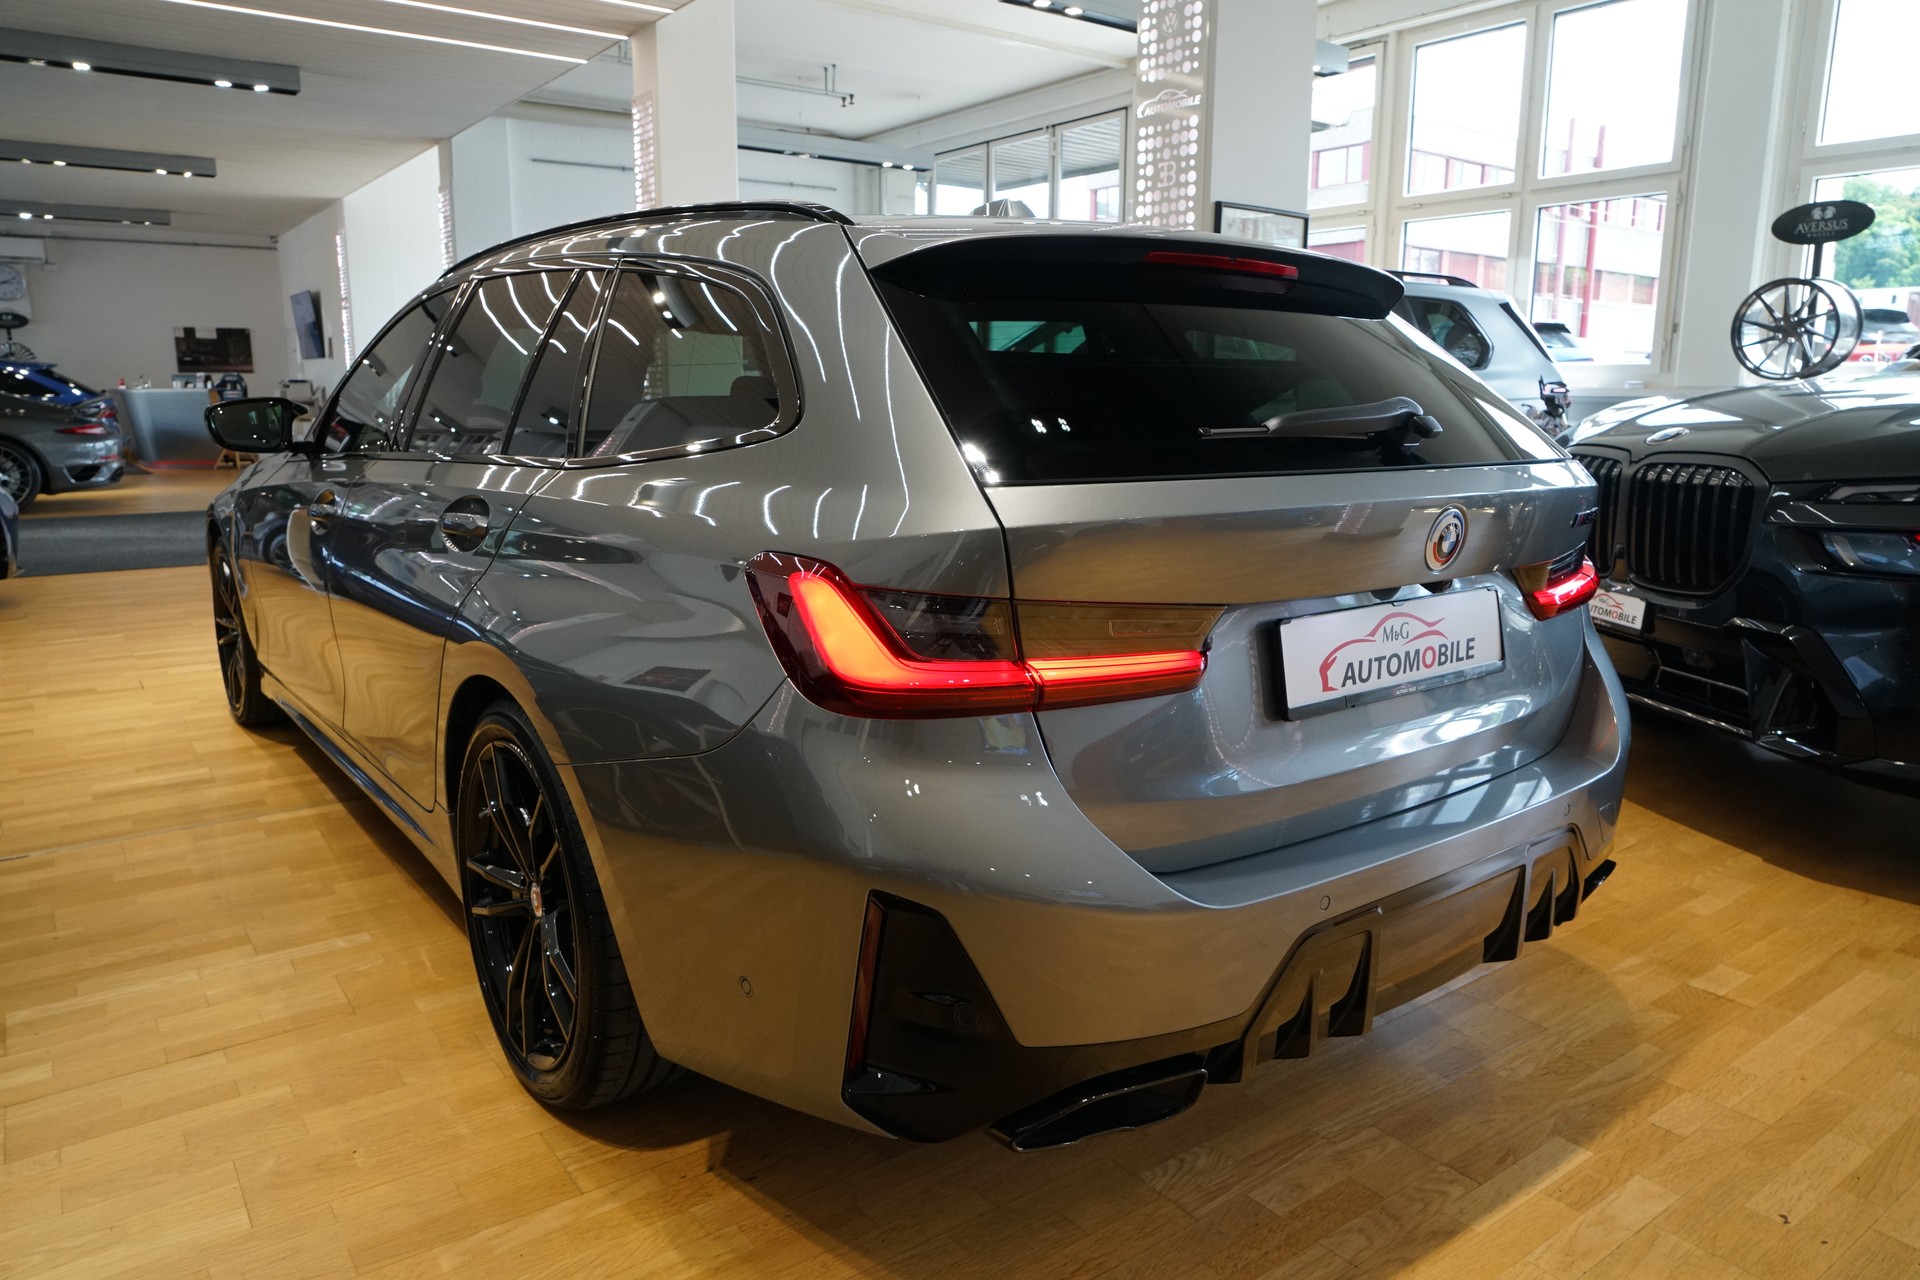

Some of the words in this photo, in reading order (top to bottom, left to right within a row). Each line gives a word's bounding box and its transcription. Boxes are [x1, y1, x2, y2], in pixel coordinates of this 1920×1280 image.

[1144, 94, 1201, 117] AUTOMOBILE
[1794, 219, 1848, 234] AVERSUS
[1590, 604, 1638, 625] UTOMOBILE
[1382, 622, 1410, 643] M&G
[1341, 637, 1476, 688] AUTOMOBILE
